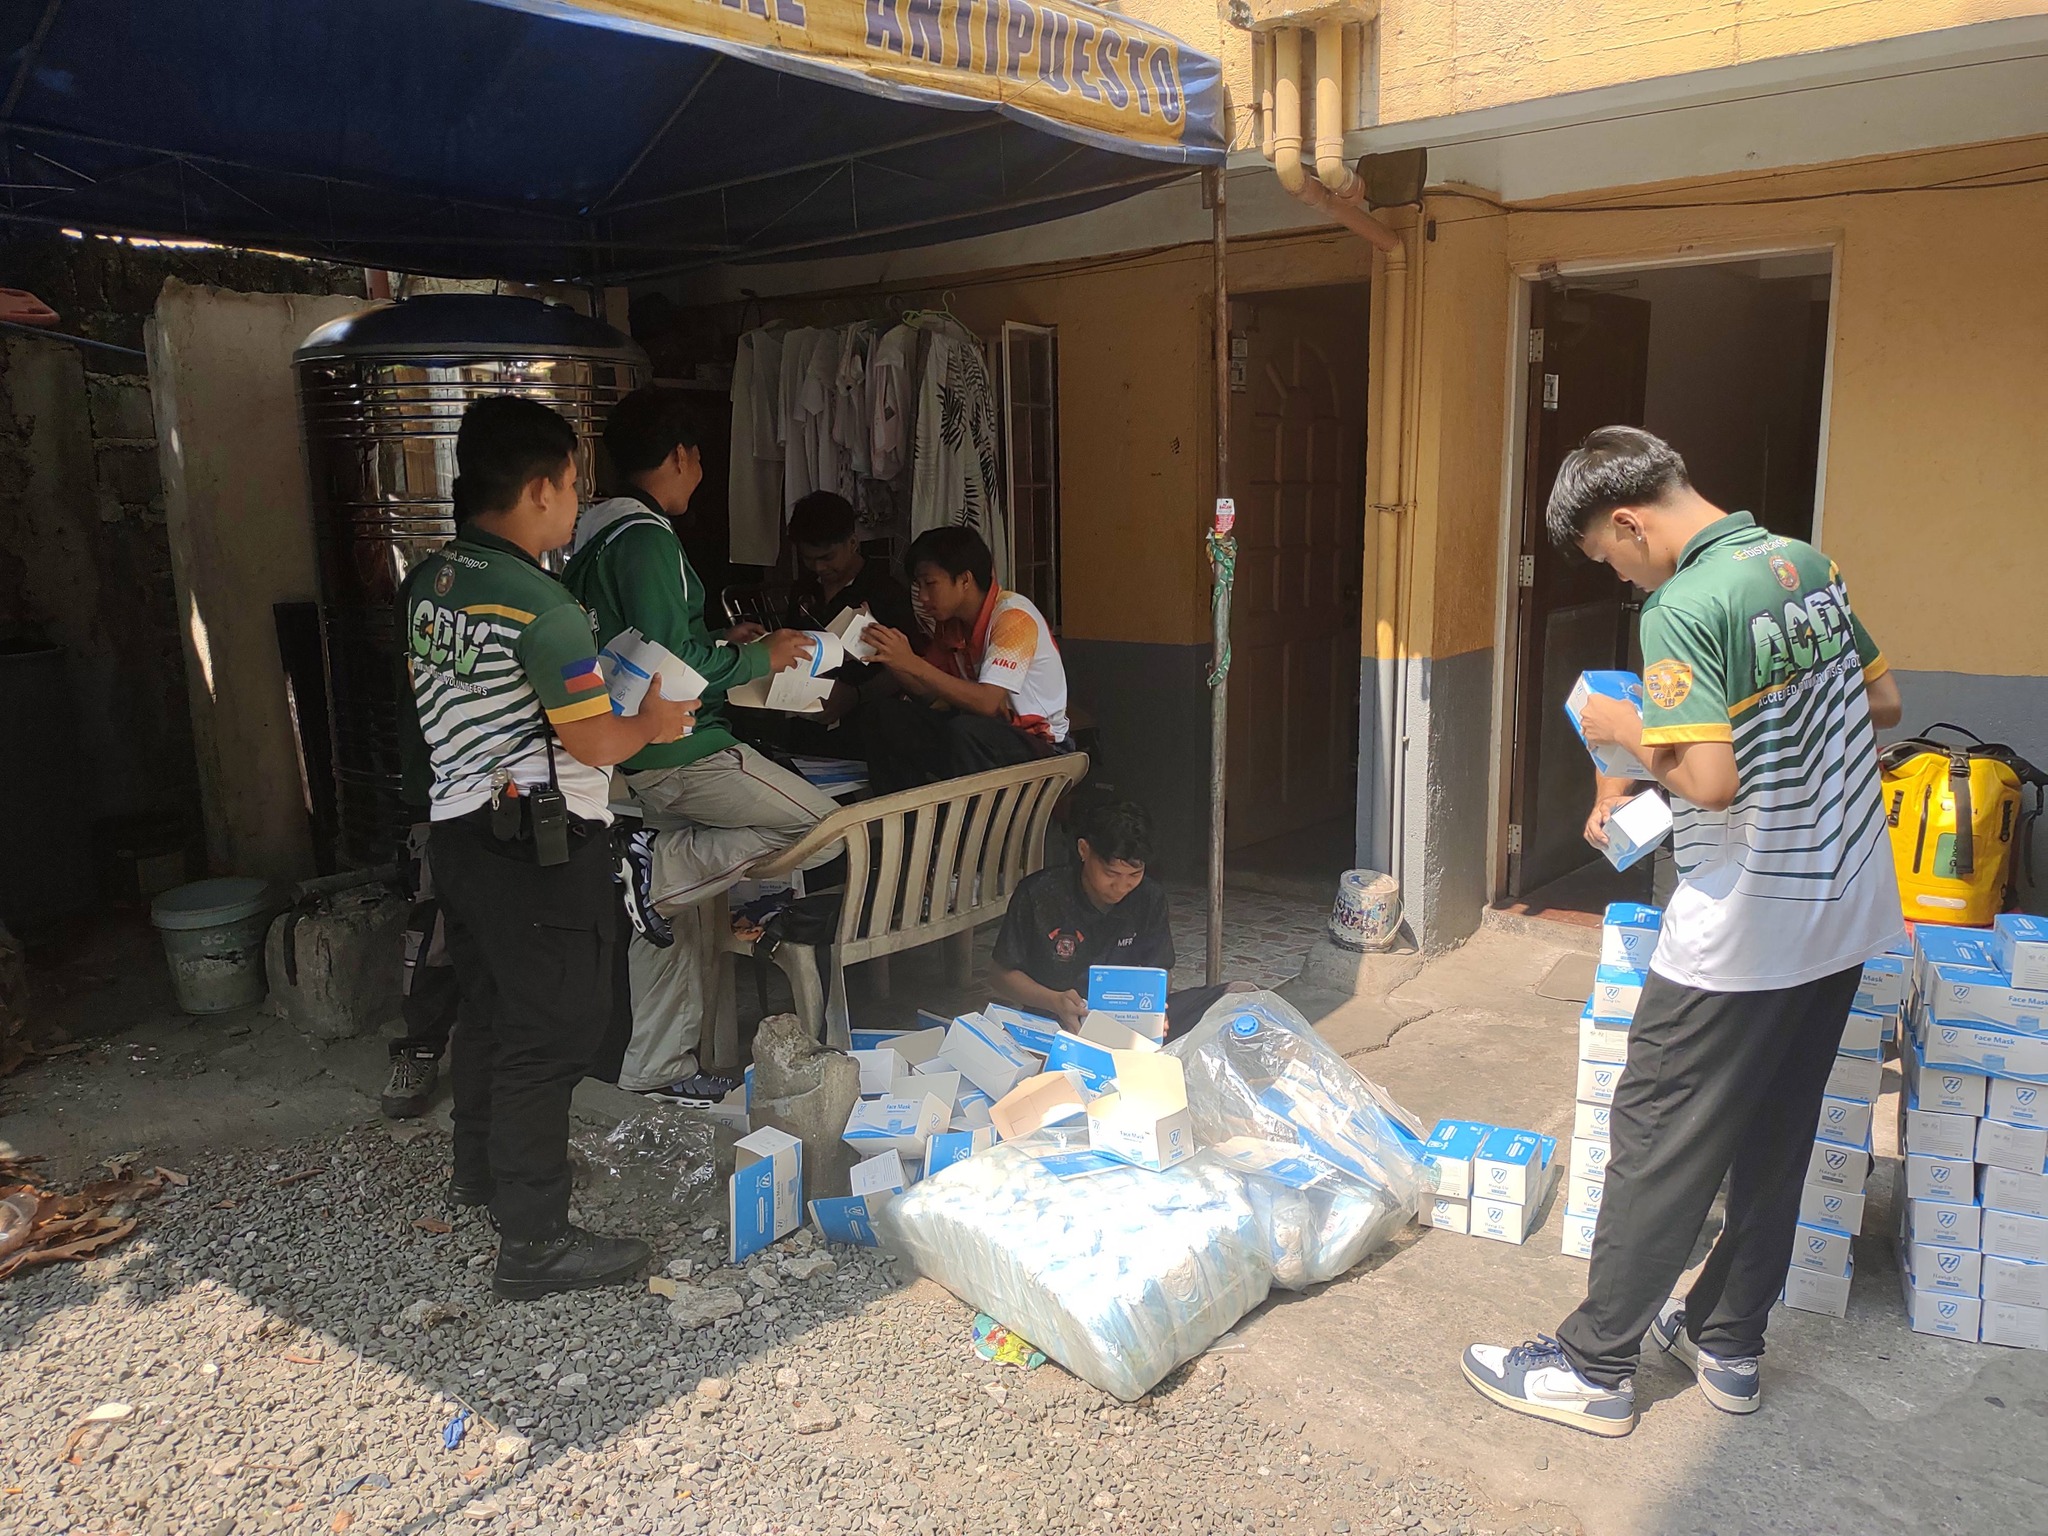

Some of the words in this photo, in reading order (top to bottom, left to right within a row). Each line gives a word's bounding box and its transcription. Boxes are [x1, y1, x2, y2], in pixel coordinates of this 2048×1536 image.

[865, 0, 1182, 124] ANTIPUESTO
[992, 658, 1018, 670] KIKO
[1863, 974, 1883, 983] Mask
[2008, 995, 2026, 1003] Face
[1974, 1034, 1992, 1042] Face
[1994, 1036, 2015, 1045] Mask
